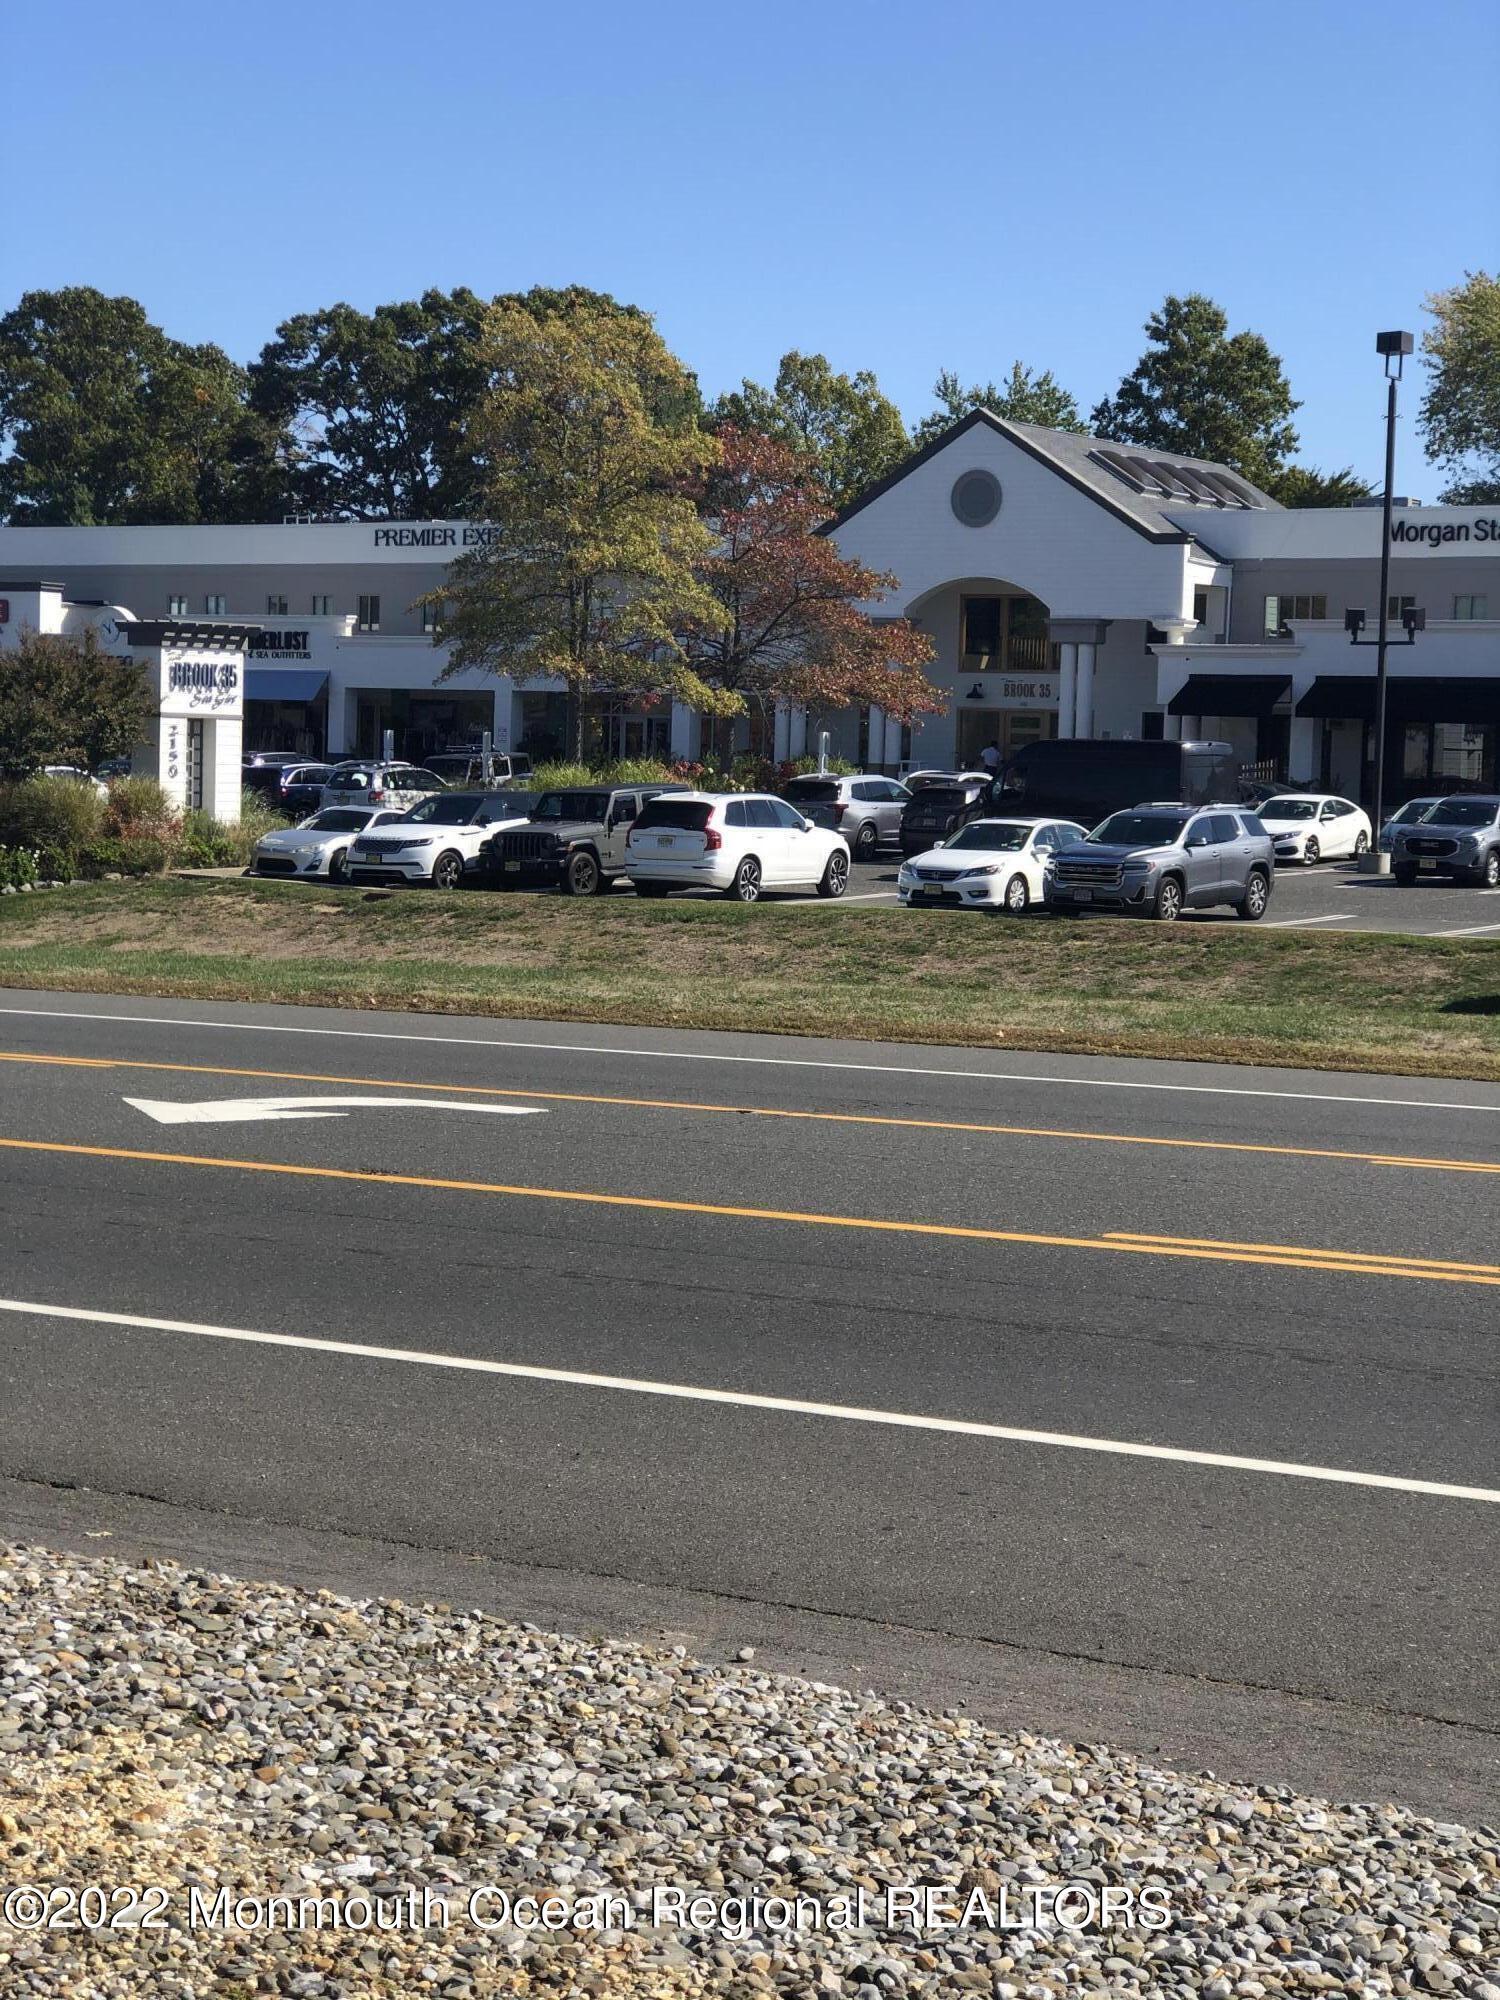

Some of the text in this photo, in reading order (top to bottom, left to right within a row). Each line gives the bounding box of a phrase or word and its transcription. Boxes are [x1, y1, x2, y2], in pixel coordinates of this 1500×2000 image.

[374, 528, 456, 547] PREMIER
[1391, 519, 1500, 548] Morgan St
[256, 651, 269, 659] SEA
[170, 662, 218, 690] BROOK
[1003, 683, 1051, 698] BROOK 35
